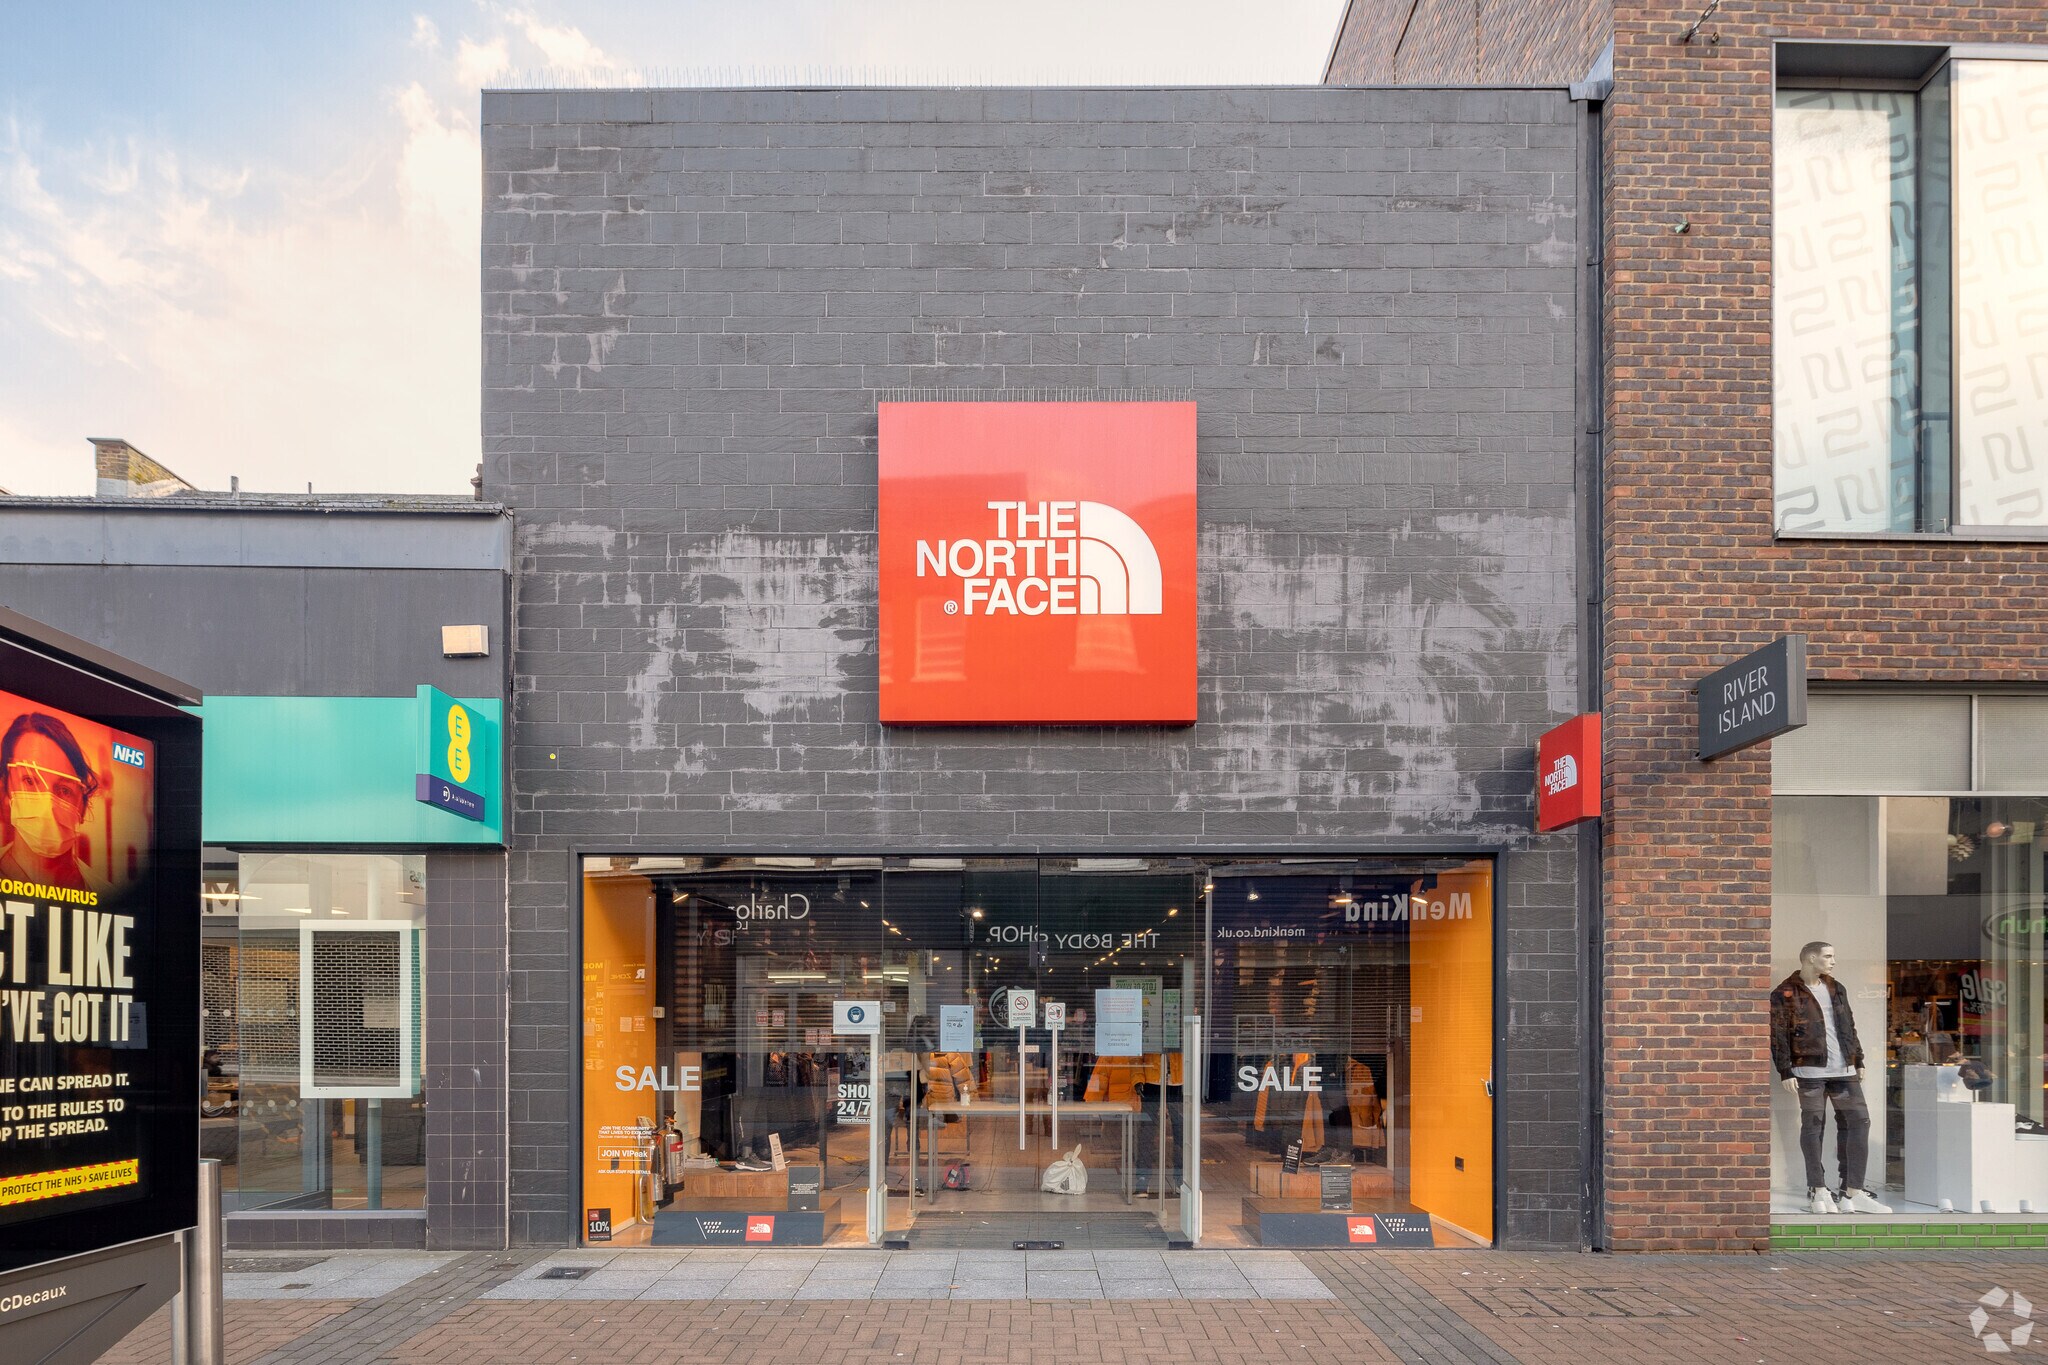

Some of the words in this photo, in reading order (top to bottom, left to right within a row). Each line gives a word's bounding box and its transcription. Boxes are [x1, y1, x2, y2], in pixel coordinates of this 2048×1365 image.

[987, 501, 1077, 538] THE
[916, 538, 1077, 577] NORTH
[963, 576, 1077, 615] FACE
[1723, 665, 1768, 705] RIVER
[1718, 691, 1776, 734] ISLAND
[113, 744, 144, 766] NHS
[1553, 756, 1567, 771] THE
[1544, 769, 1566, 787] NORTH
[1550, 778, 1567, 795] FACE
[0, 878, 98, 906] ORONAVIRUS
[48, 906, 134, 989] LIKE
[54, 991, 103, 1043] GOT
[110, 994, 133, 1042] IT
[19, 1076, 53, 1092] CAN
[57, 1074, 112, 1090] SPREAD
[115, 1073, 130, 1086] IT.
[615, 1065, 700, 1092] SALE
[1237, 1065, 1323, 1092] SALE
[2, 1105, 24, 1121] TO
[27, 1103, 56, 1119] THE
[60, 1099, 104, 1117] RULES
[107, 1098, 125, 1112] TO
[837, 1100, 870, 1116] 24/7
[15, 1123, 46, 1140] THE
[48, 1118, 108, 1137] SPREAD.
[601, 1149, 620, 1157] JOIN
[621, 1149, 648, 1158] VIPeak
[2, 1181, 43, 1197] PROTECT
[45, 1179, 62, 1190] THE
[64, 1175, 82, 1187] NHS
[88, 1171, 109, 1183] SAVE
[110, 1168, 132, 1179] LIVES
[589, 1221, 610, 1232] 10%
[0, 1285, 67, 1312] CDecaux
